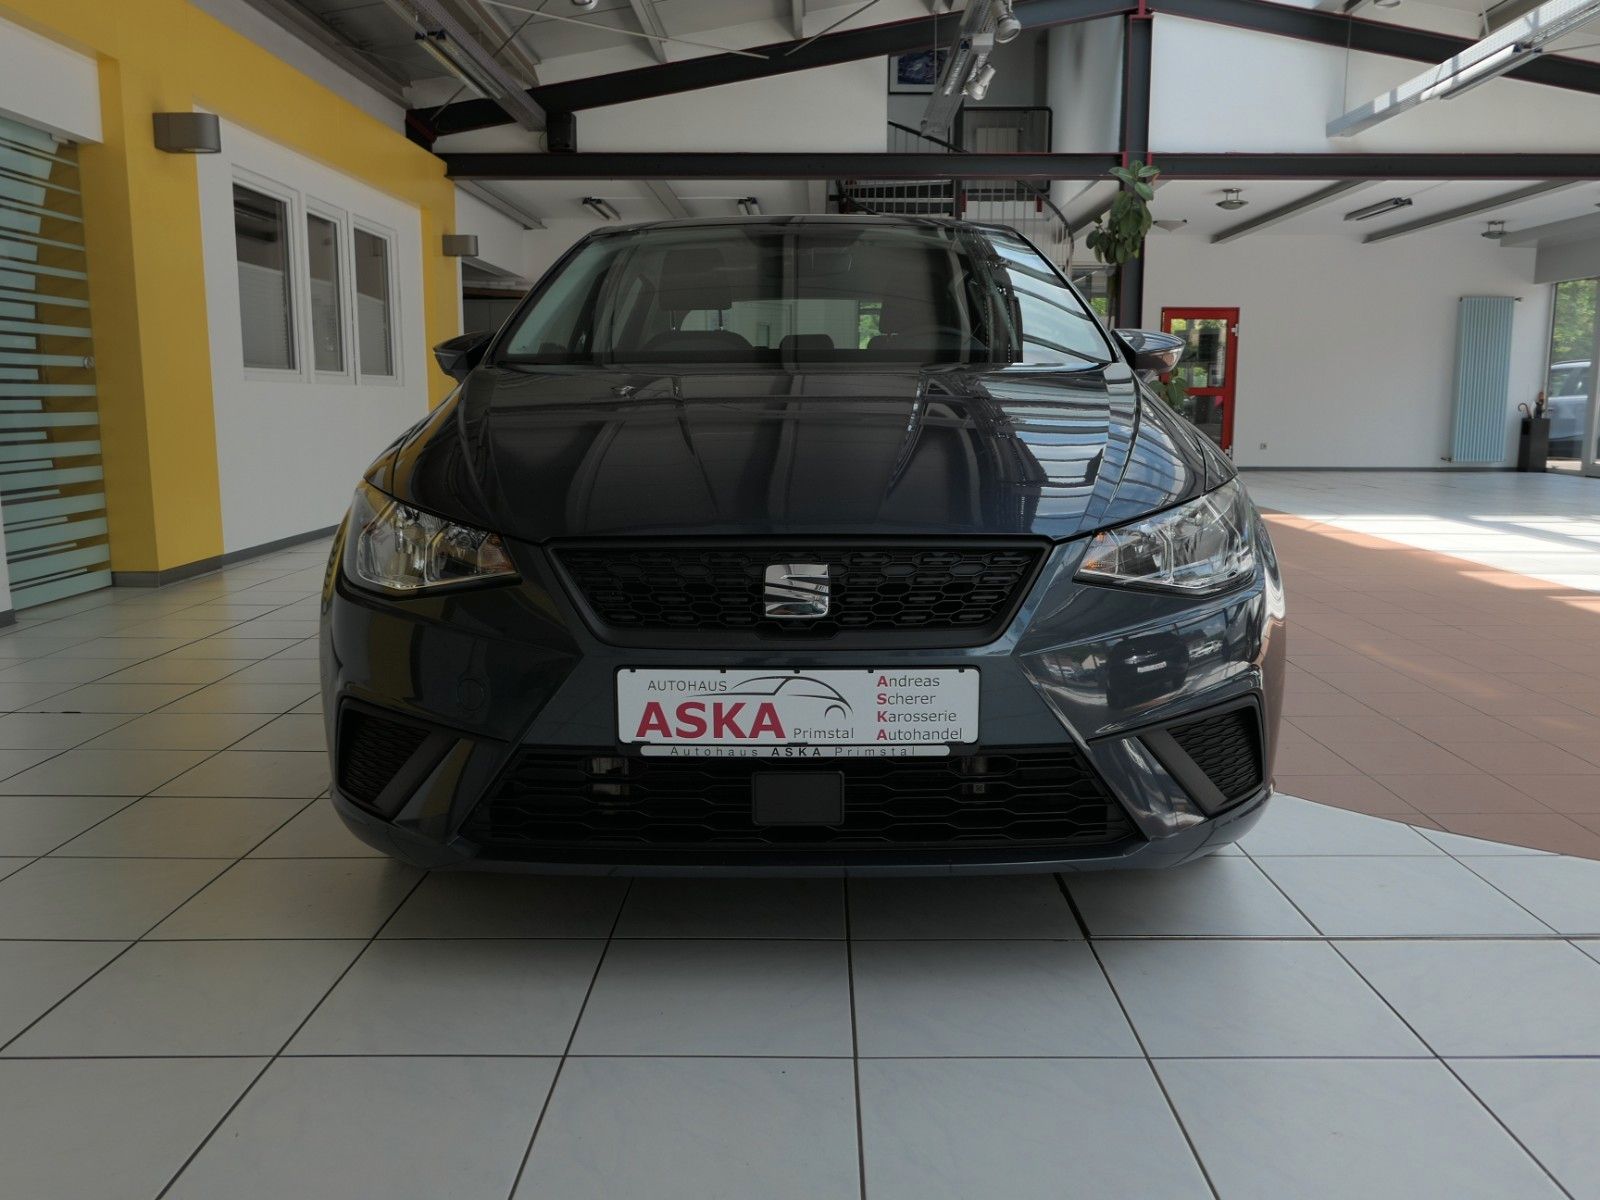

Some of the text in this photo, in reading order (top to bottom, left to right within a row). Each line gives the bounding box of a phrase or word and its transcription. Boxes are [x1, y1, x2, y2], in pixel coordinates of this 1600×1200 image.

[647, 680, 728, 693] AUTOHAUS
[876, 674, 941, 688] Andreas
[876, 692, 937, 706] Scherer
[635, 701, 787, 739] ASKA
[876, 709, 957, 723] Karosserie
[793, 727, 855, 740] Primstal
[876, 727, 963, 742] Autohandel
[670, 746, 916, 757] Autohaus ASKA Primstal
